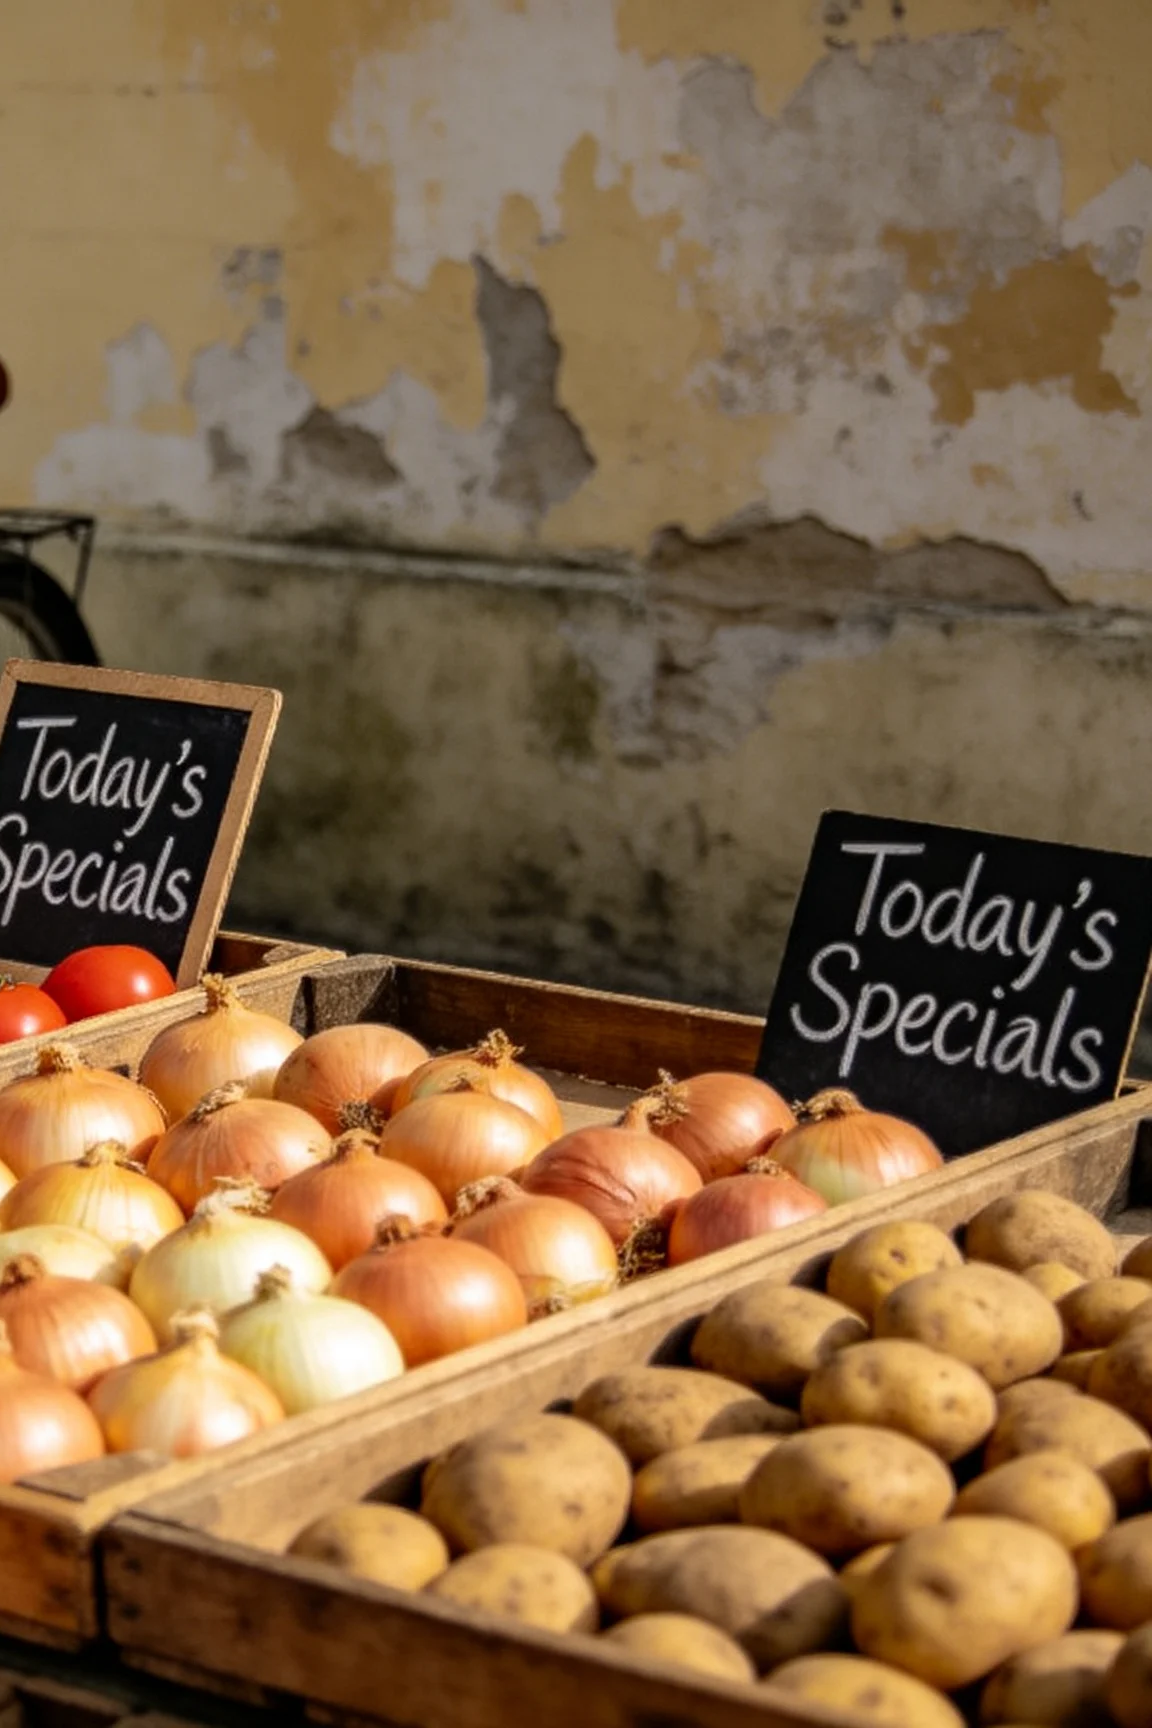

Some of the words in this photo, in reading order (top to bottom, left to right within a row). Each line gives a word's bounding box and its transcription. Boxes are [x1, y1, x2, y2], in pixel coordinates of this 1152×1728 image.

[16, 716, 208, 838] Today's
[841, 843, 1118, 992] Today's
[790, 942, 1104, 1094] Specials
